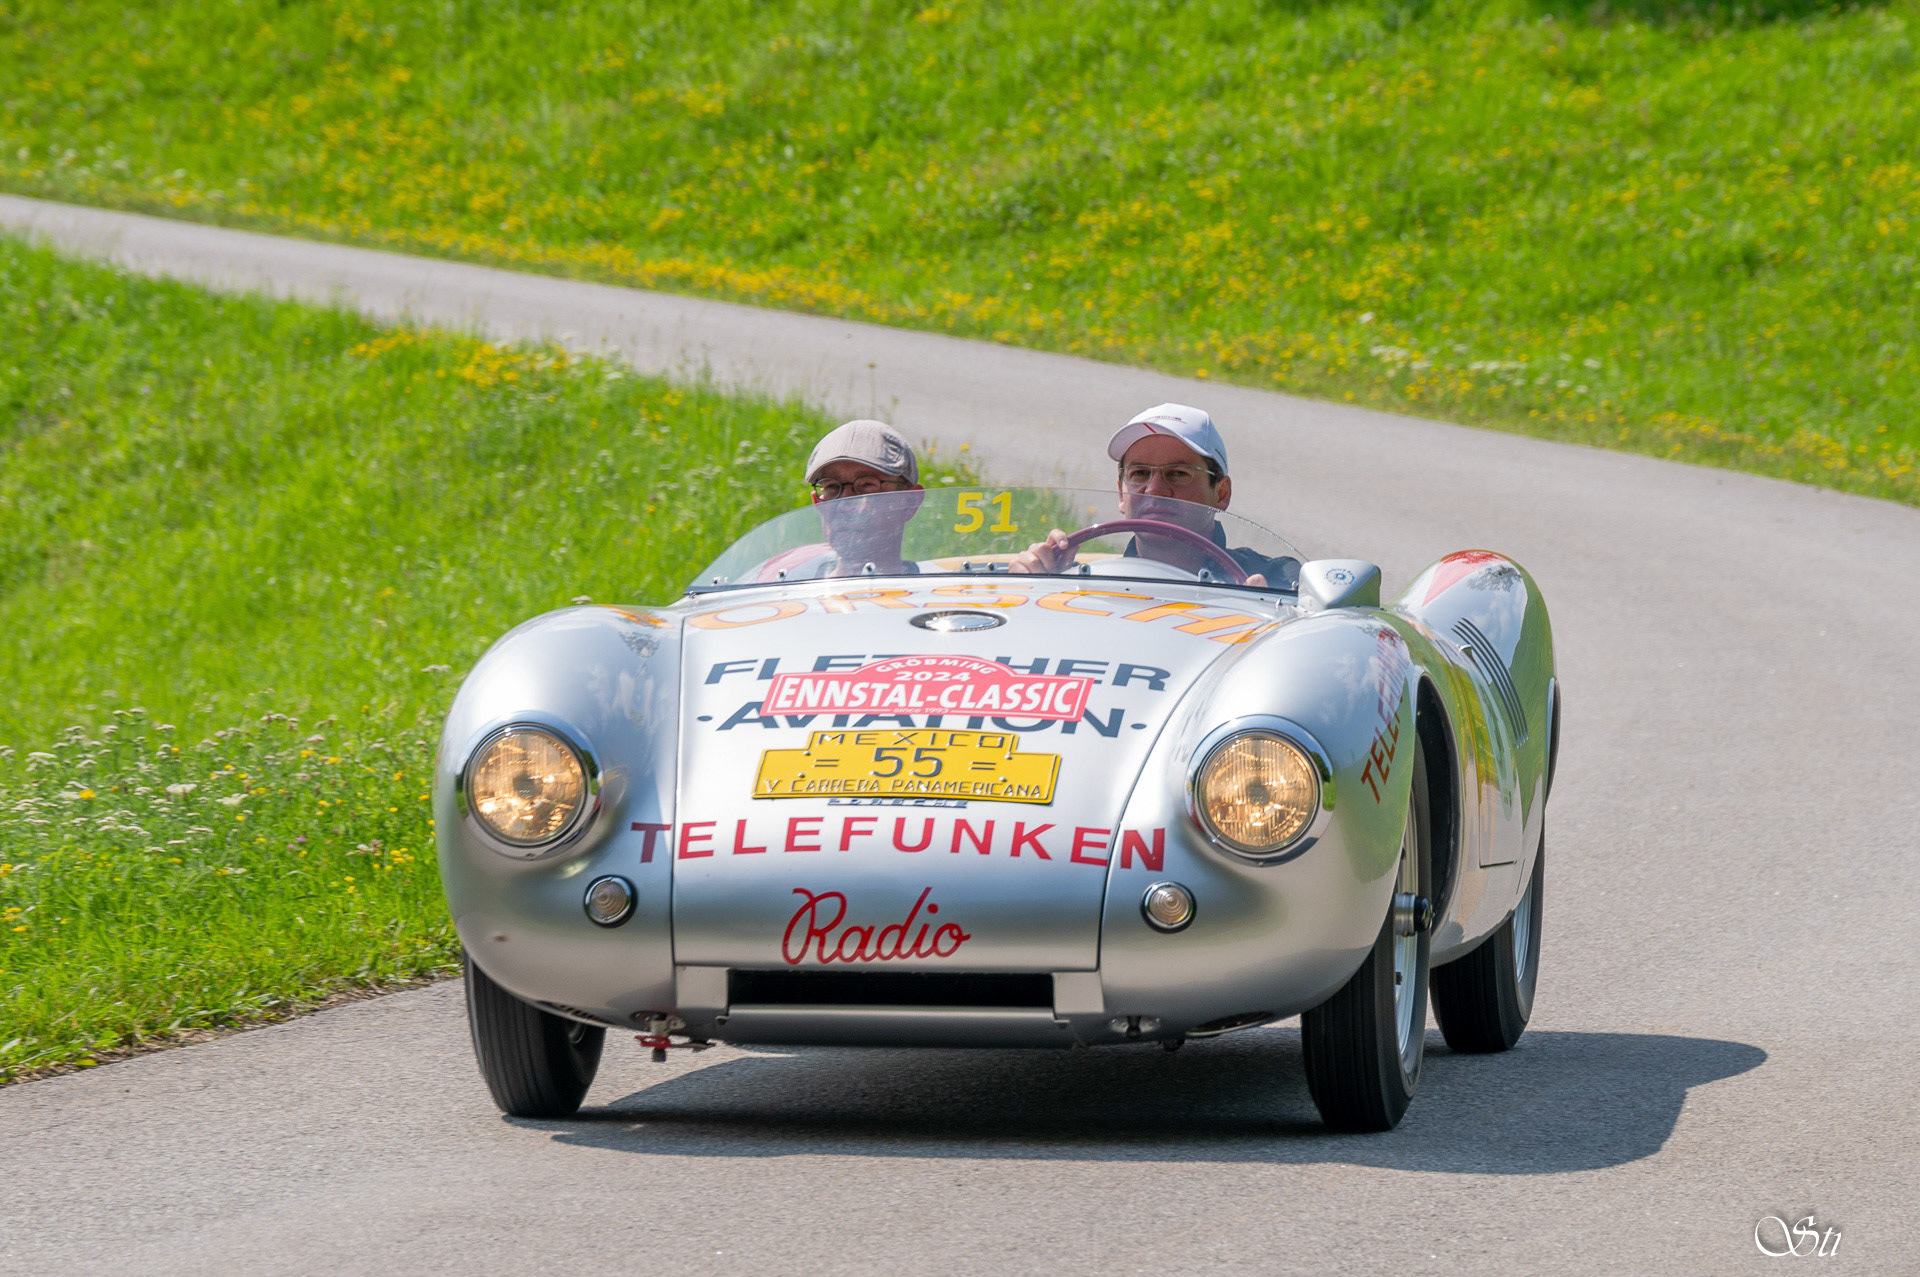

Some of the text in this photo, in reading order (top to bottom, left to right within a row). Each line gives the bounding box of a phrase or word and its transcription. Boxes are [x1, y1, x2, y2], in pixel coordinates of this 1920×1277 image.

[953, 491, 1019, 533] 51
[875, 658, 998, 675] GRÖBMING
[893, 670, 972, 682] 2024
[774, 677, 1081, 714] ENNSTAL-CLASSIC
[818, 732, 1005, 749] MEXICO
[869, 747, 947, 778] 55
[763, 778, 1042, 798] V CARRERA PANAMERICANA
[630, 816, 1166, 872] TELEFUNKEN
[781, 886, 972, 966] Radio
